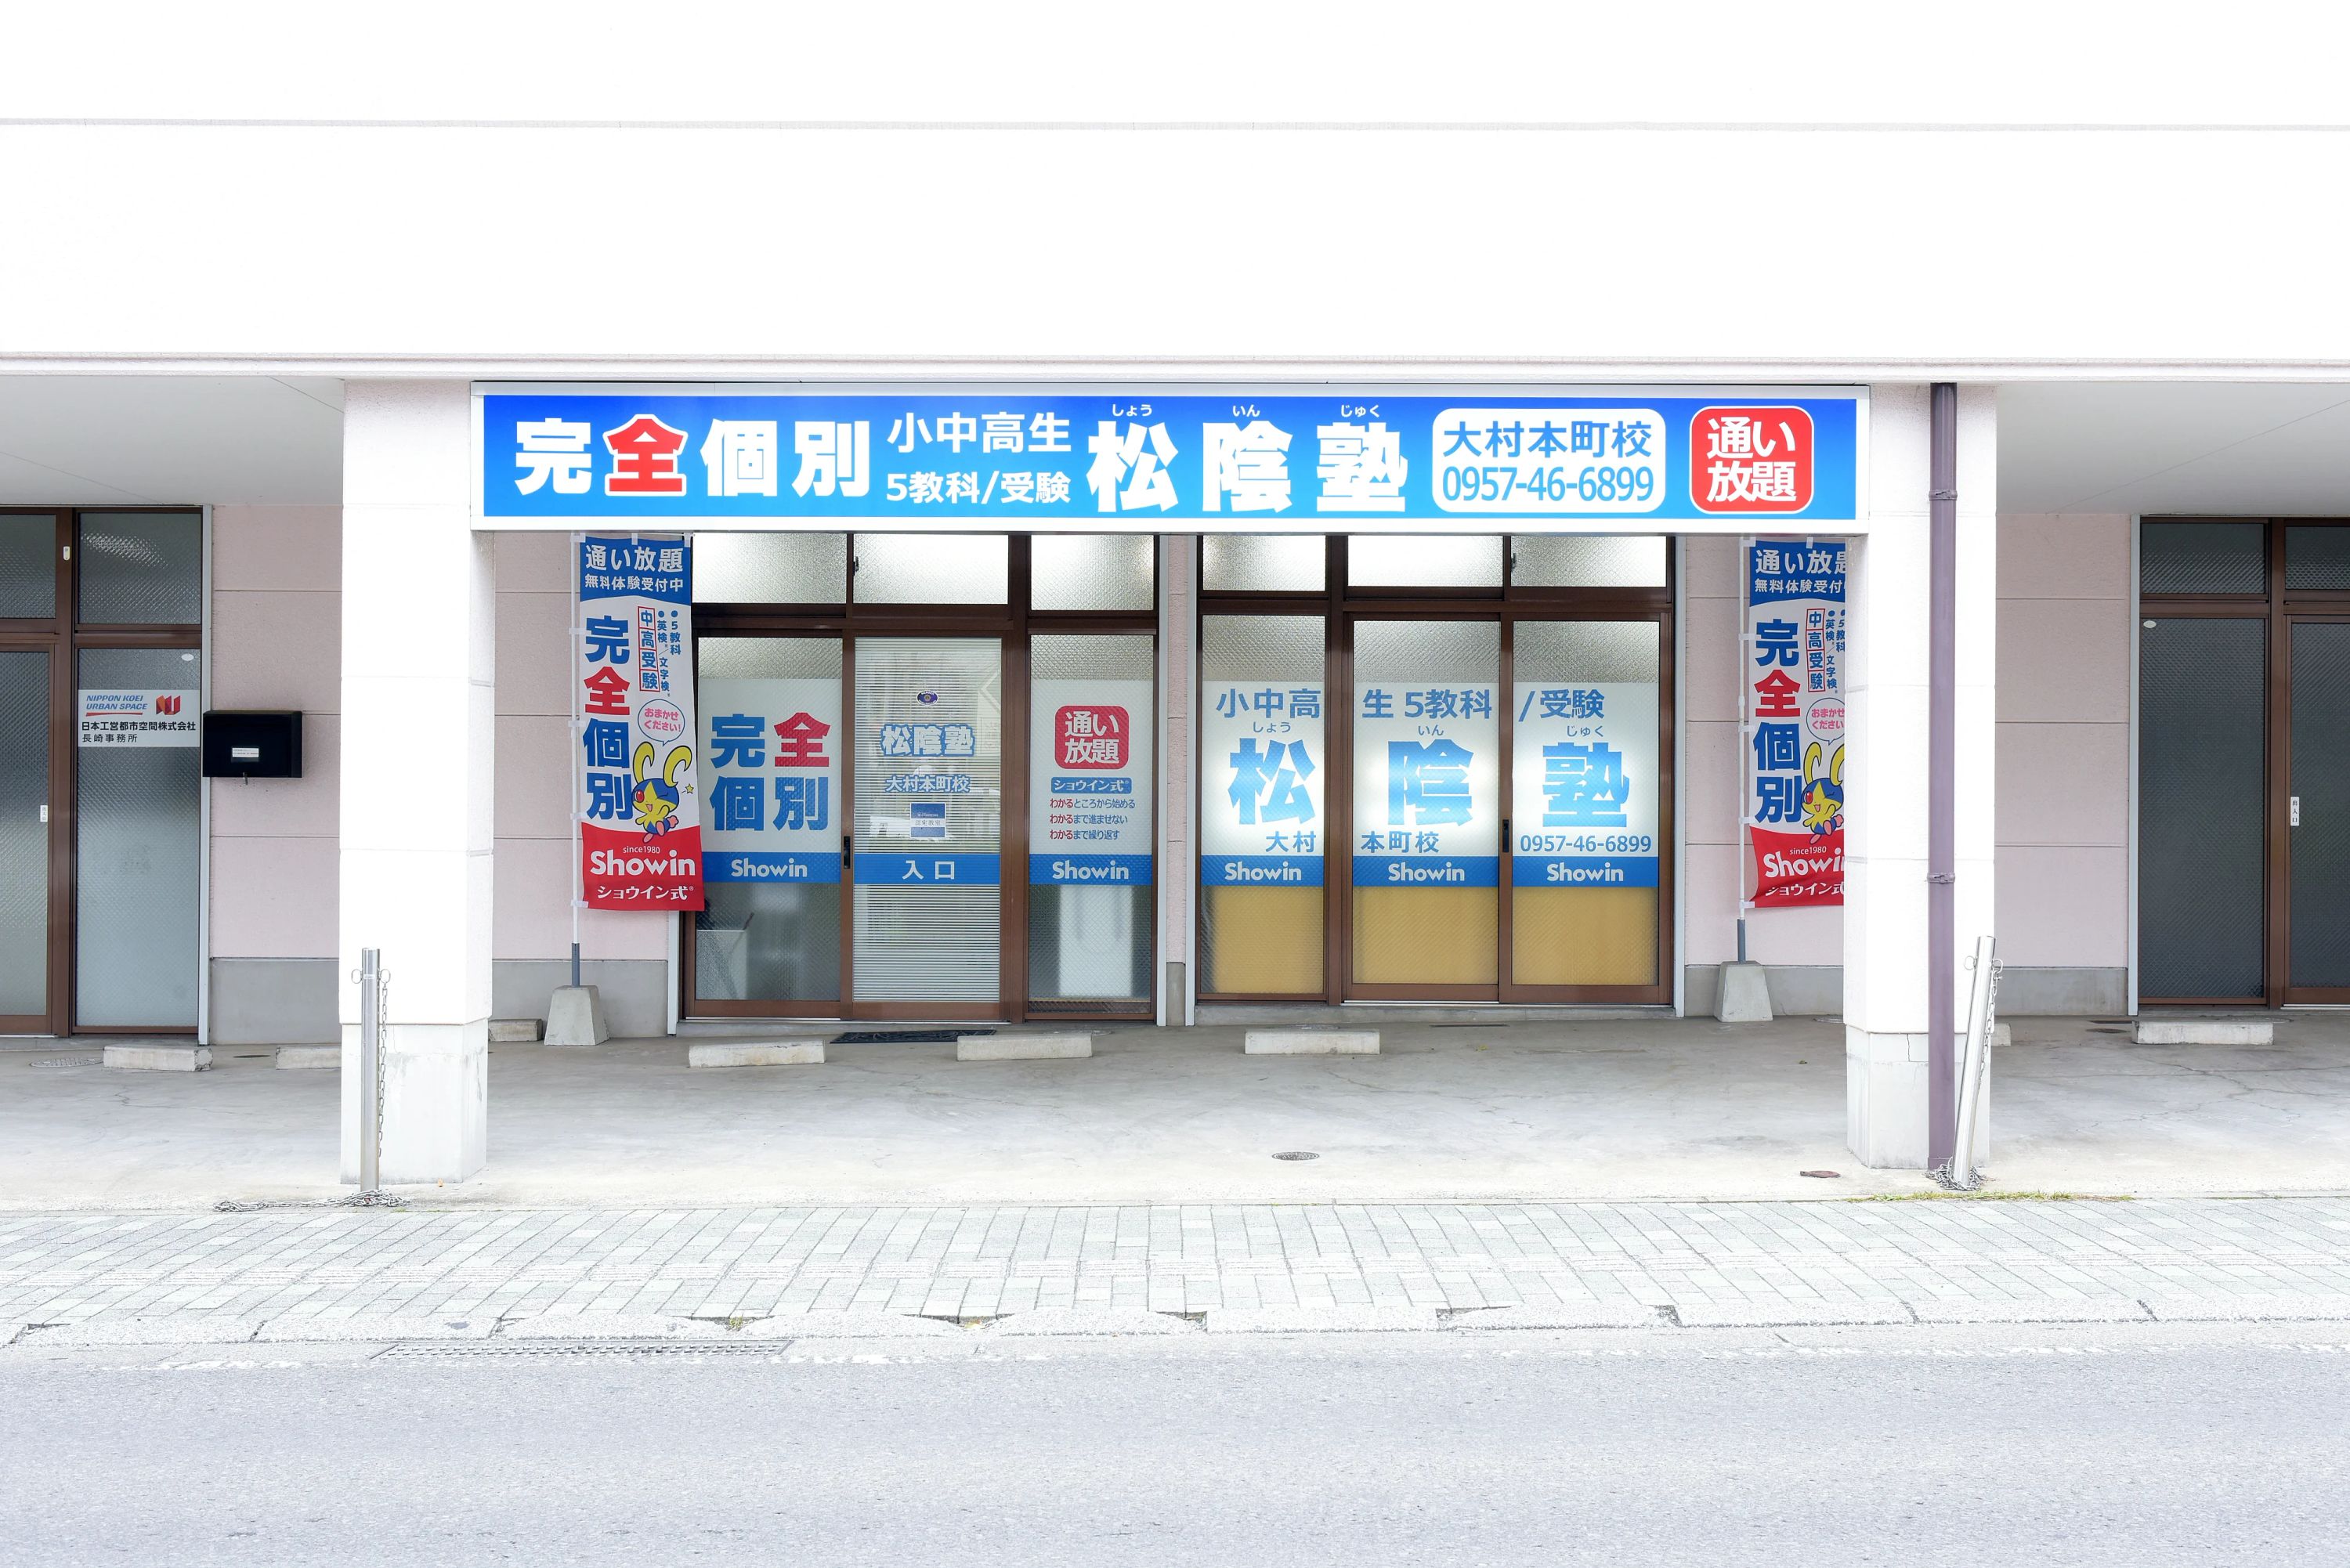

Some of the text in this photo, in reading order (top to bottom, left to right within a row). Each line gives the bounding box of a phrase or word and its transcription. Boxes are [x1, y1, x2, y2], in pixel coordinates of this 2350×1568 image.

[1112, 403, 1380, 417] しょう いん じゅく
[886, 411, 1072, 453] 小中高生
[1443, 421, 1652, 458] 大村本町校
[1706, 417, 1795, 460] 通い
[515, 414, 870, 497] 完全個別
[1086, 421, 1408, 513] 松陰塾
[886, 471, 1072, 504] 5教科/受験
[1442, 466, 1654, 502] 0957-46-6899
[1705, 461, 1796, 502] 放題
[585, 544, 684, 573] 通い放題
[584, 573, 684, 592] 無料体験受付中
[1755, 578, 1846, 594] 無料体験受付
[640, 609, 659, 690] 中高受験
[1807, 610, 1824, 690] 中高受験
[644, 707, 679, 721] おまかせ
[1217, 688, 1321, 719] 小中高
[81, 721, 196, 731] 日本工営都市空間株式会社
[583, 615, 634, 820] 完全個別
[1065, 710, 1119, 738] 通い
[1253, 721, 1605, 738] しょう いん じゅく
[1753, 618, 1802, 824] 完全個別
[82, 733, 138, 743] 長崎事務所
[710, 712, 831, 768] 完全
[880, 724, 975, 757] 松陰塾
[1064, 738, 1119, 764] 放題
[885, 774, 971, 793] 大村本町校
[1227, 738, 1630, 828] 松 陰 塾
[709, 775, 829, 832] 個別
[1050, 797, 1136, 809] わかるところから始める
[1050, 814, 1128, 825] わかるまで進ませない
[1050, 829, 1120, 840] わかるまで繰り返す
[1265, 830, 1440, 854] 大村 本町校
[1520, 835, 1652, 853] 0957-46-6899
[623, 845, 660, 854] since1980
[1789, 846, 1828, 855] since1980
[590, 849, 696, 876] Showin
[731, 858, 808, 879] Showin
[902, 860, 956, 880] 入口
[1052, 859, 1130, 880] Showin
[1224, 861, 1302, 882] Showin
[1388, 862, 1465, 882] Showin
[1546, 862, 1624, 883] Showin
